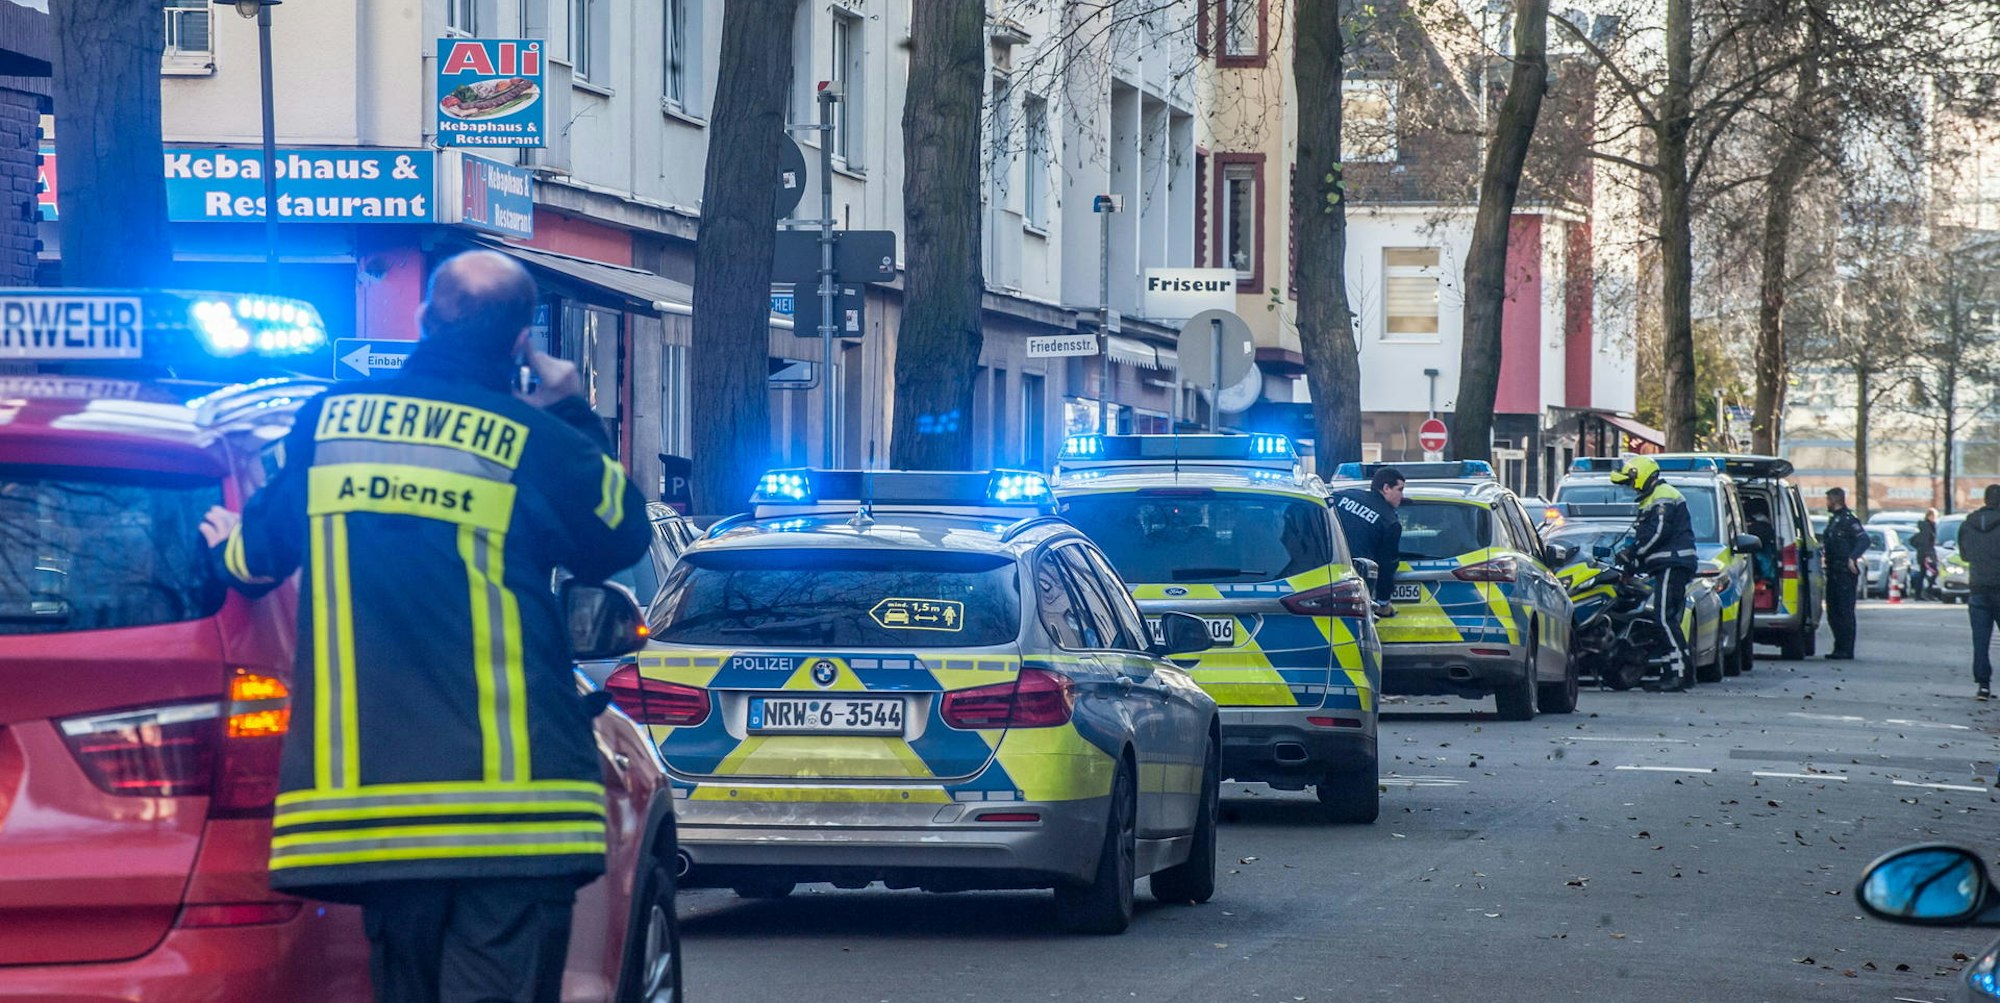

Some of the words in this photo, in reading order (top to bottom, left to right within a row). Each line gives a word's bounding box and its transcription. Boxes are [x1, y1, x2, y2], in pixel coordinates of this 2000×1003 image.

[442, 42, 540, 76] Ali
[440, 121, 522, 132] Kebaphaus
[527, 122, 537, 132] &
[456, 134, 540, 144] Restaurant
[391, 155, 419, 179] &
[463, 159, 488, 224] Ali
[488, 164, 524, 197] Kebaphaus
[524, 174, 530, 197] &
[495, 203, 532, 233] Restaurant
[1148, 277, 1231, 292] Friseur
[0, 302, 137, 347] RWEHR
[1030, 338, 1094, 353] Friedensstr.
[323, 400, 517, 460] FEUERWEHR
[338, 475, 475, 513] A-Dienst
[1337, 497, 1381, 524] POLIZEI
[912, 602, 930, 612] 1,5
[732, 657, 794, 671] POLIZEI
[764, 701, 807, 726] NRW
[820, 702, 900, 727] 6-3544
